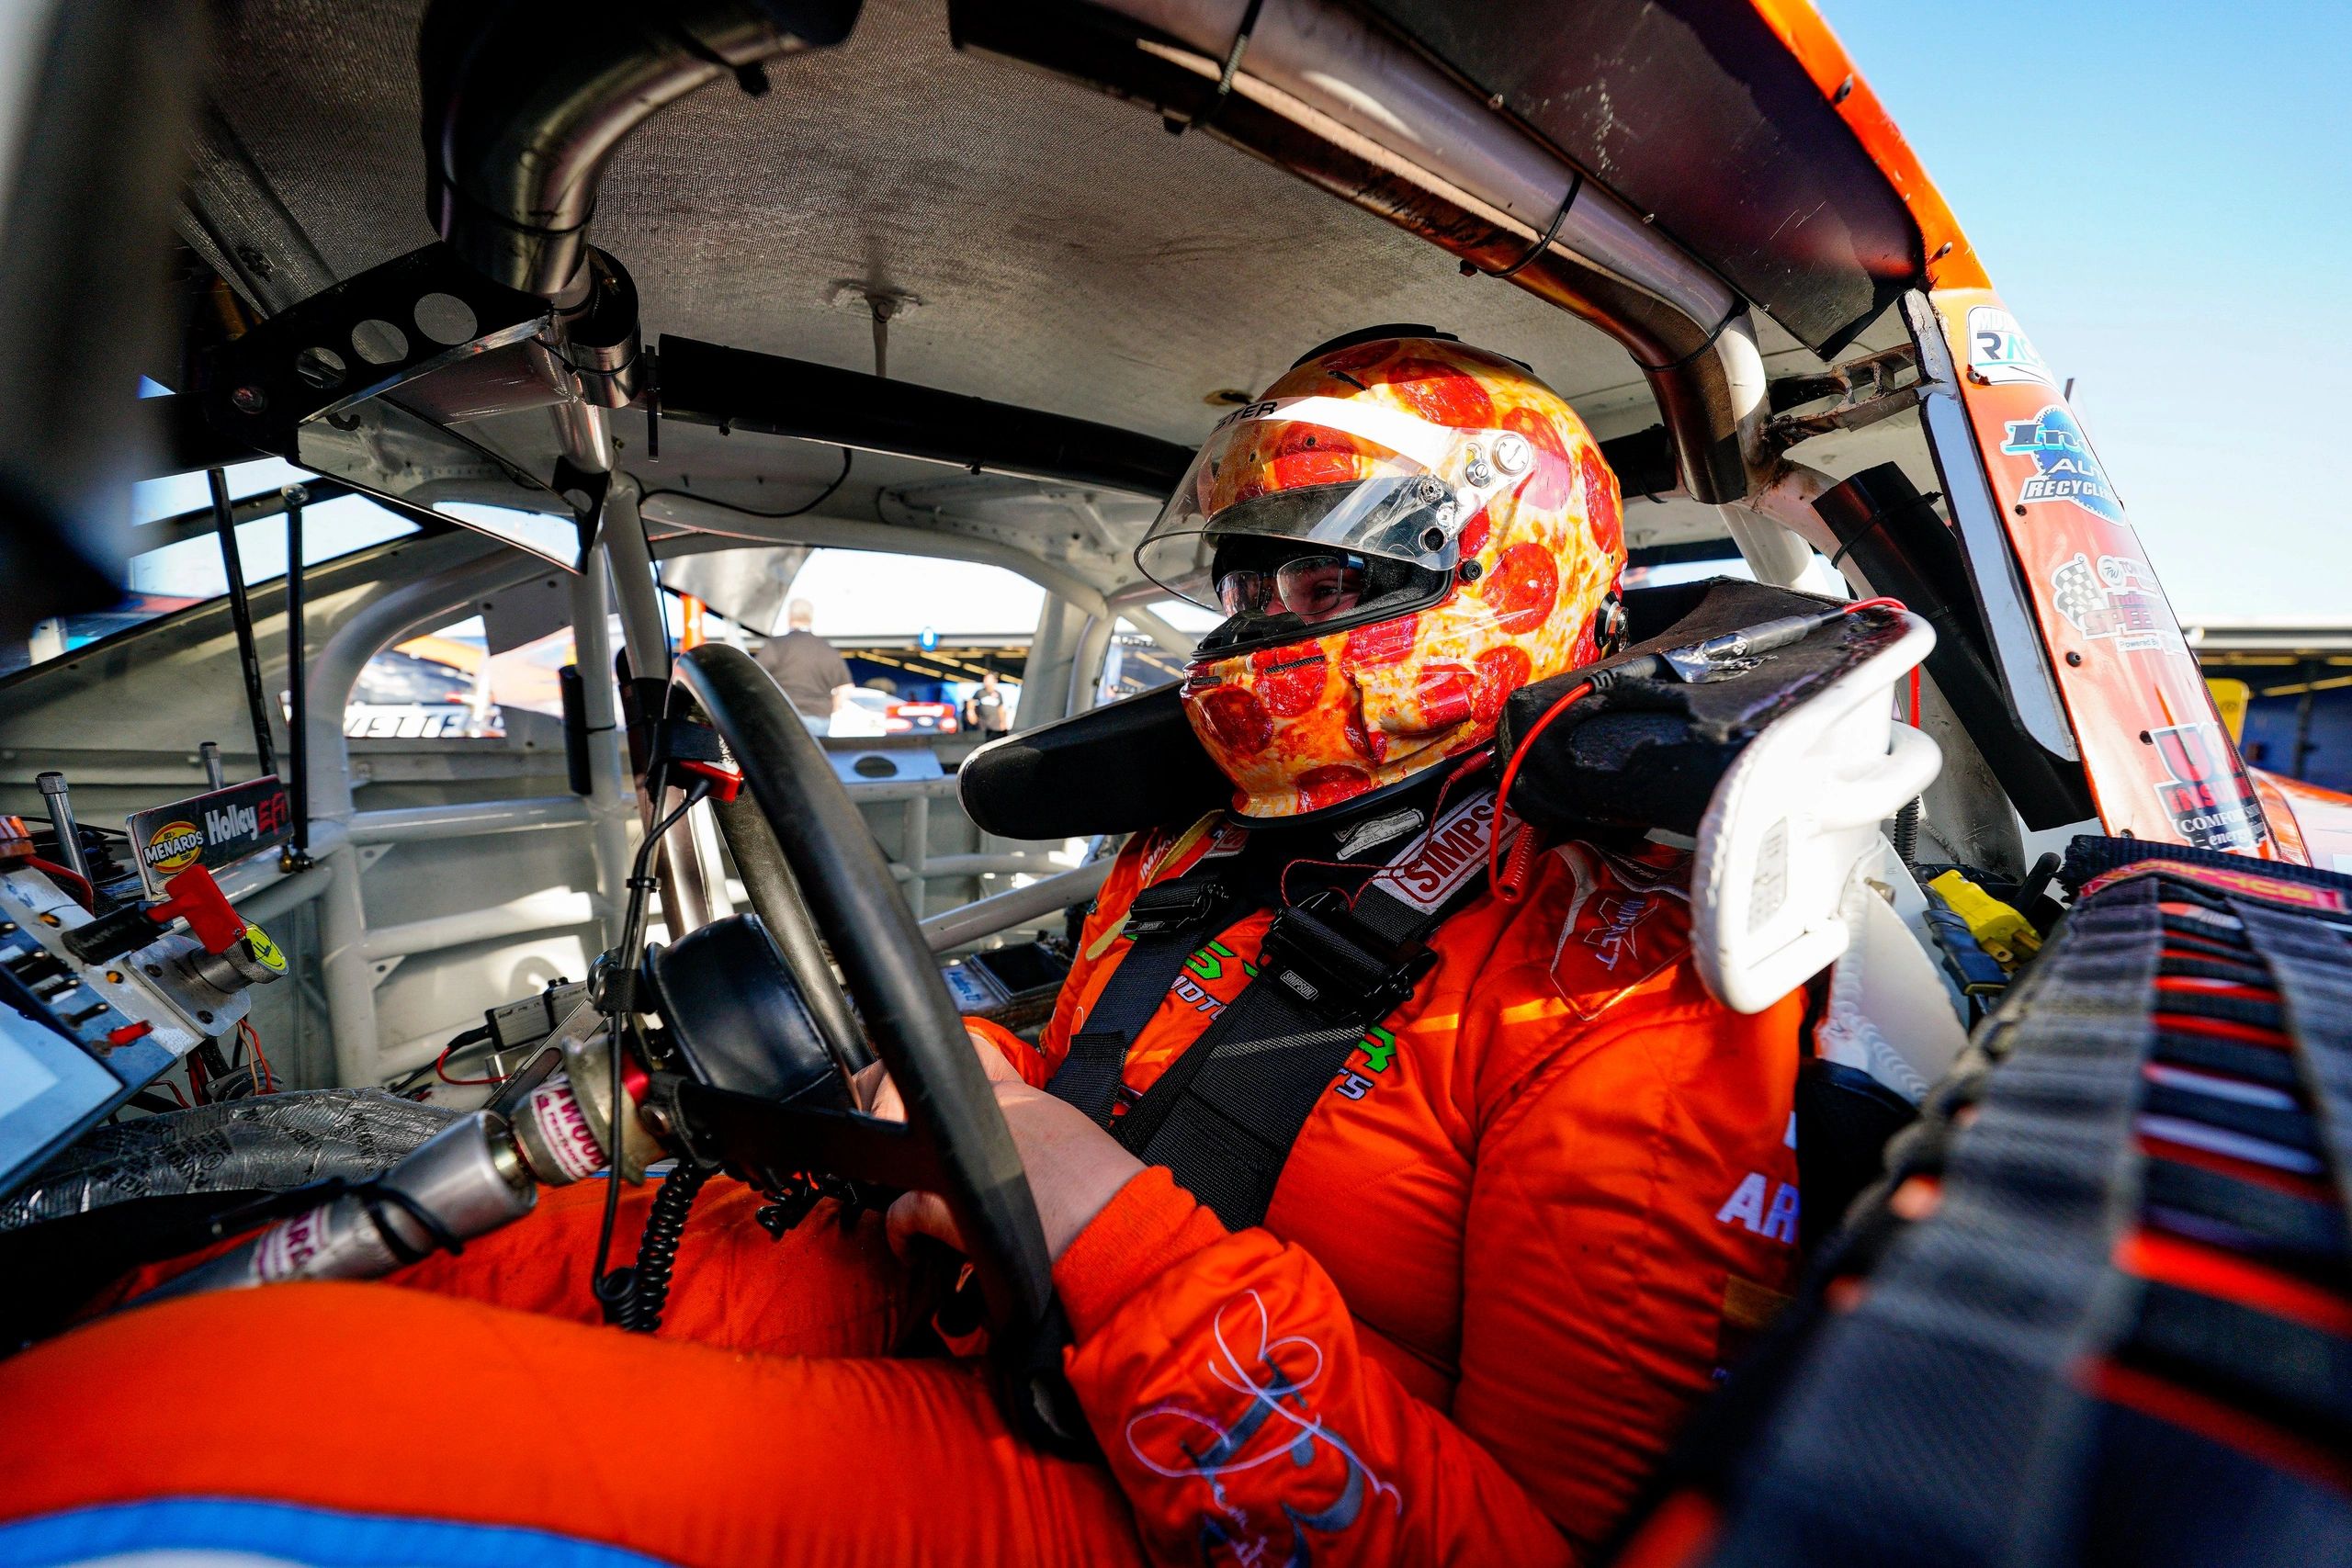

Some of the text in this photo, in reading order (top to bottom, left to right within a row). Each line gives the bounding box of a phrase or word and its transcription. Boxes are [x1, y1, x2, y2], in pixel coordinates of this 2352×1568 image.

[143, 831, 204, 865] MENARDS
[205, 804, 258, 846] Holley
[1283, 972, 1316, 998] SIMPSON
